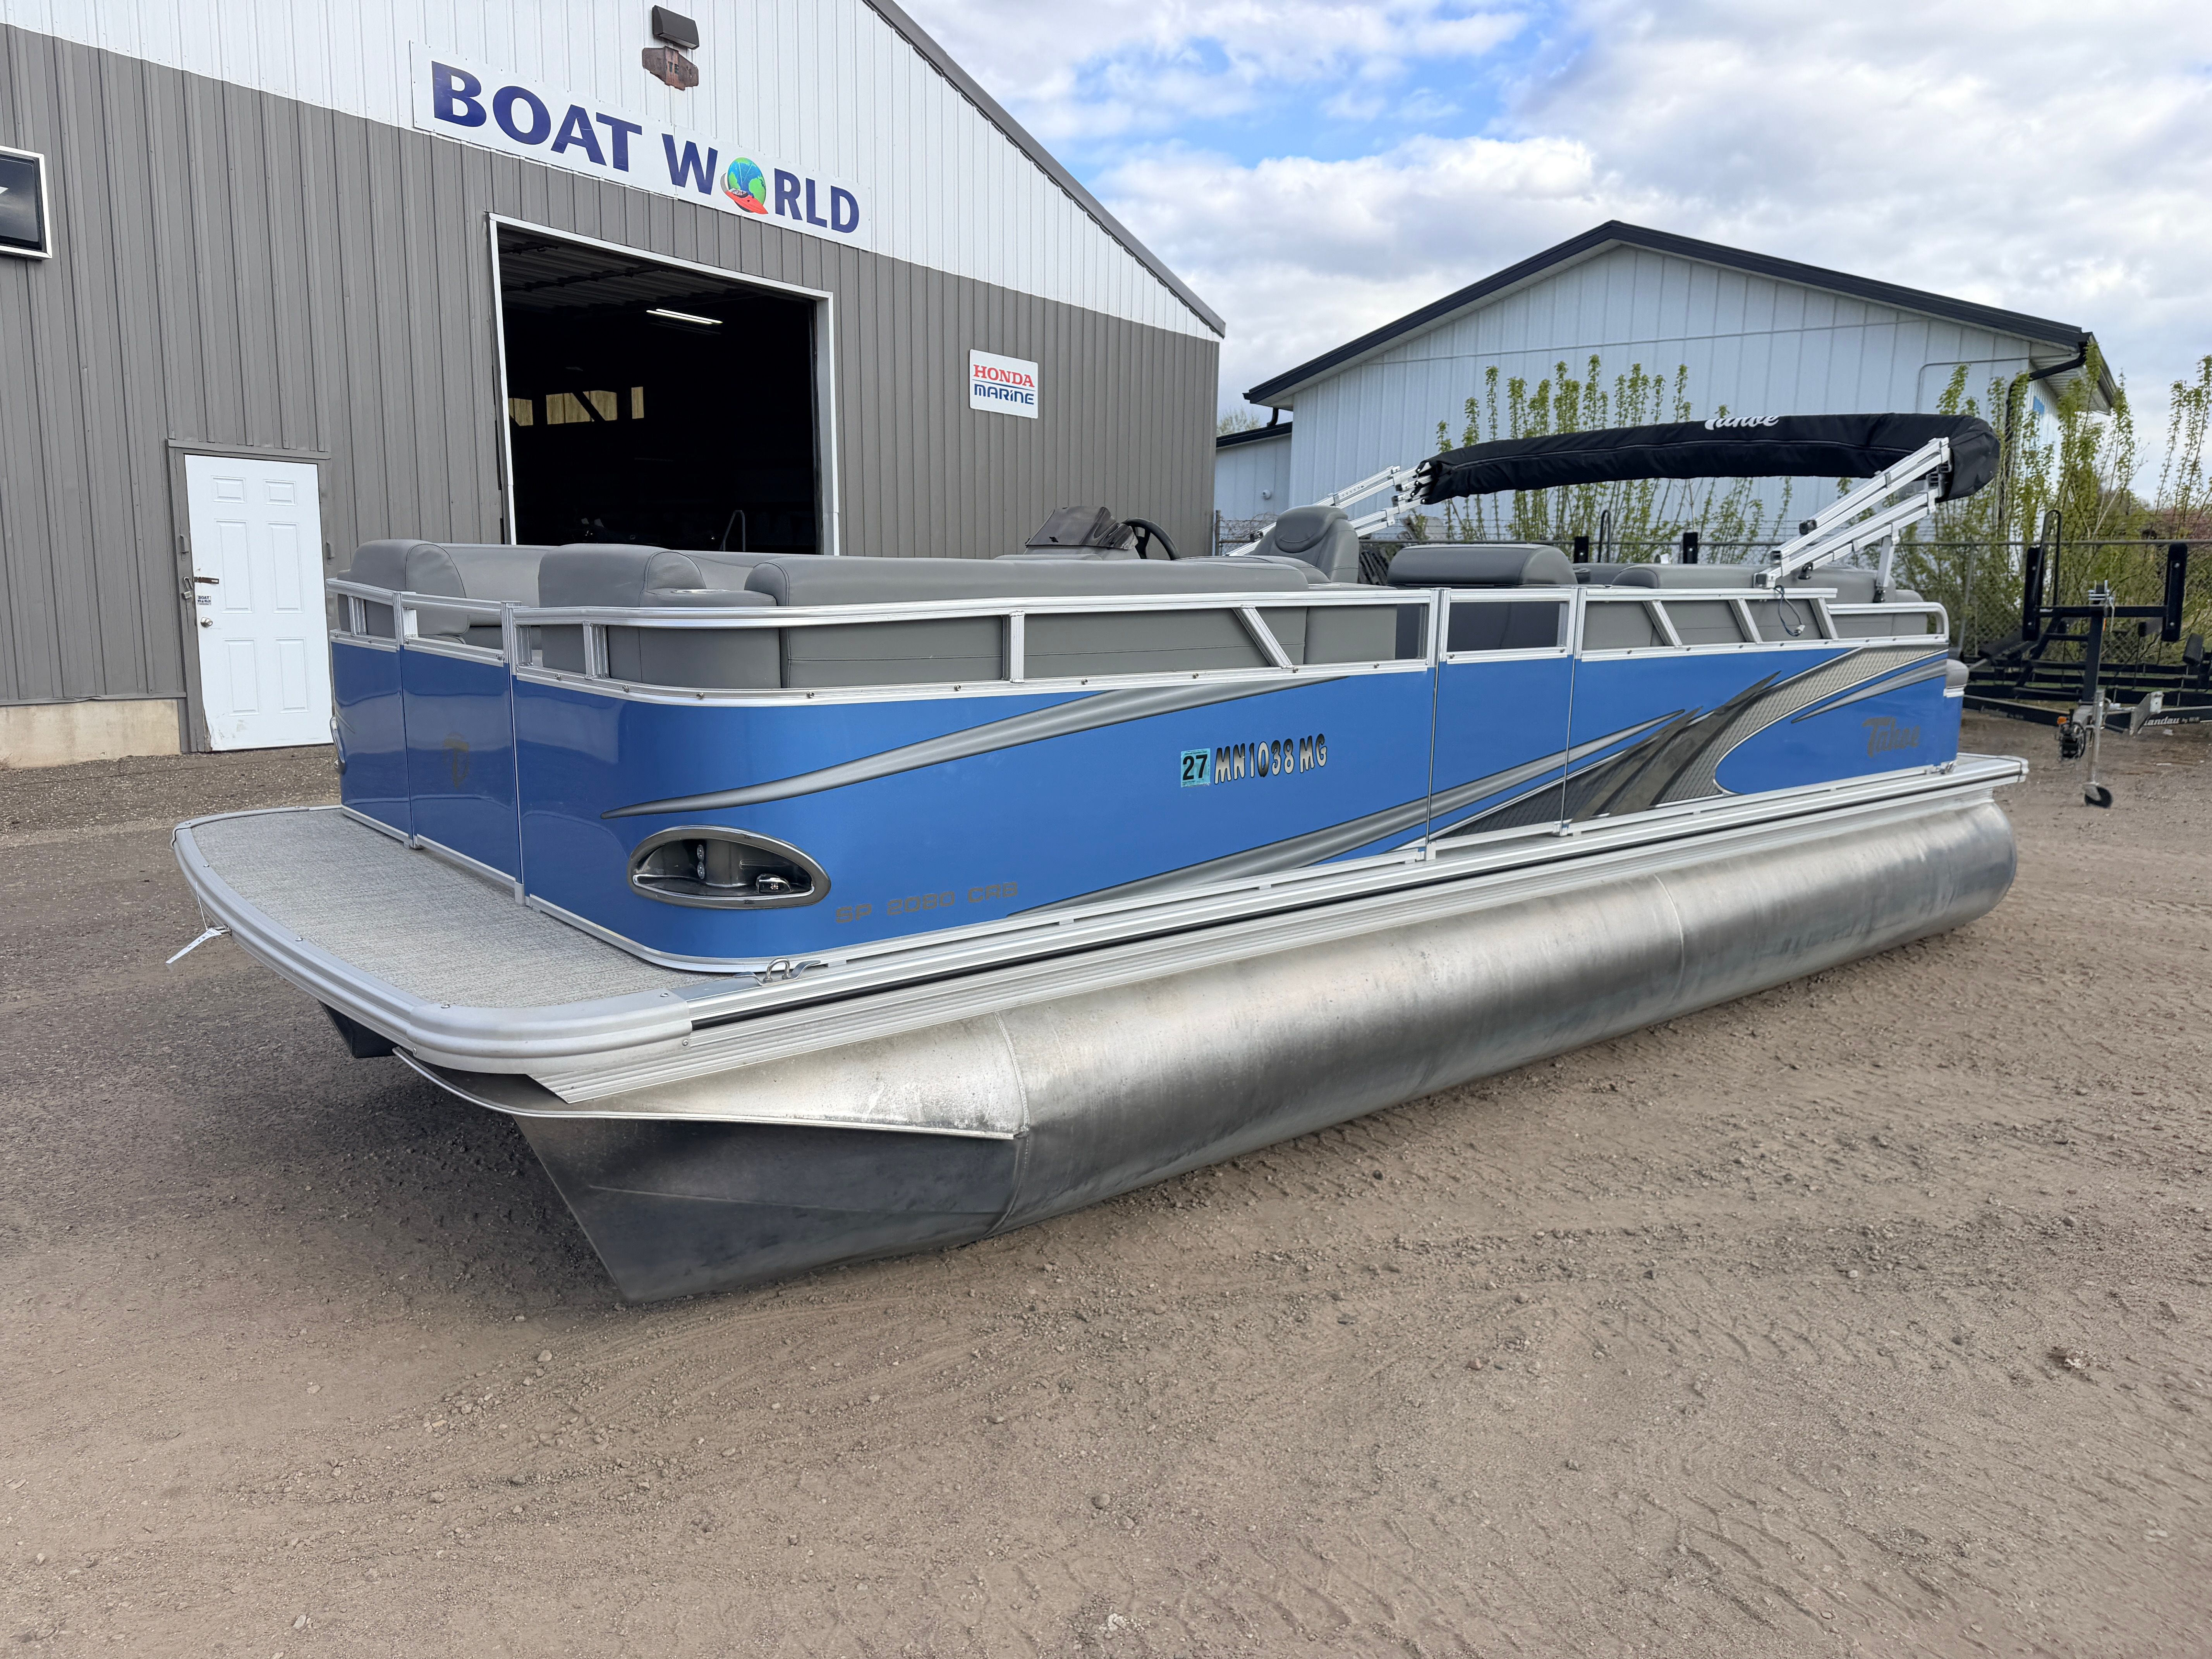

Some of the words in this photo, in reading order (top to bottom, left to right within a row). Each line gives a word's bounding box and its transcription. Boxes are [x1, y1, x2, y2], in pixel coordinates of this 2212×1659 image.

[431, 60, 642, 172] BOAT
[973, 364, 1035, 387] HONDA
[1300, 733, 1327, 773] MG
[1862, 716, 1921, 758] Tahoe
[1183, 754, 1207, 780] 27
[835, 903, 872, 924] SP
[886, 891, 955, 915] 2080
